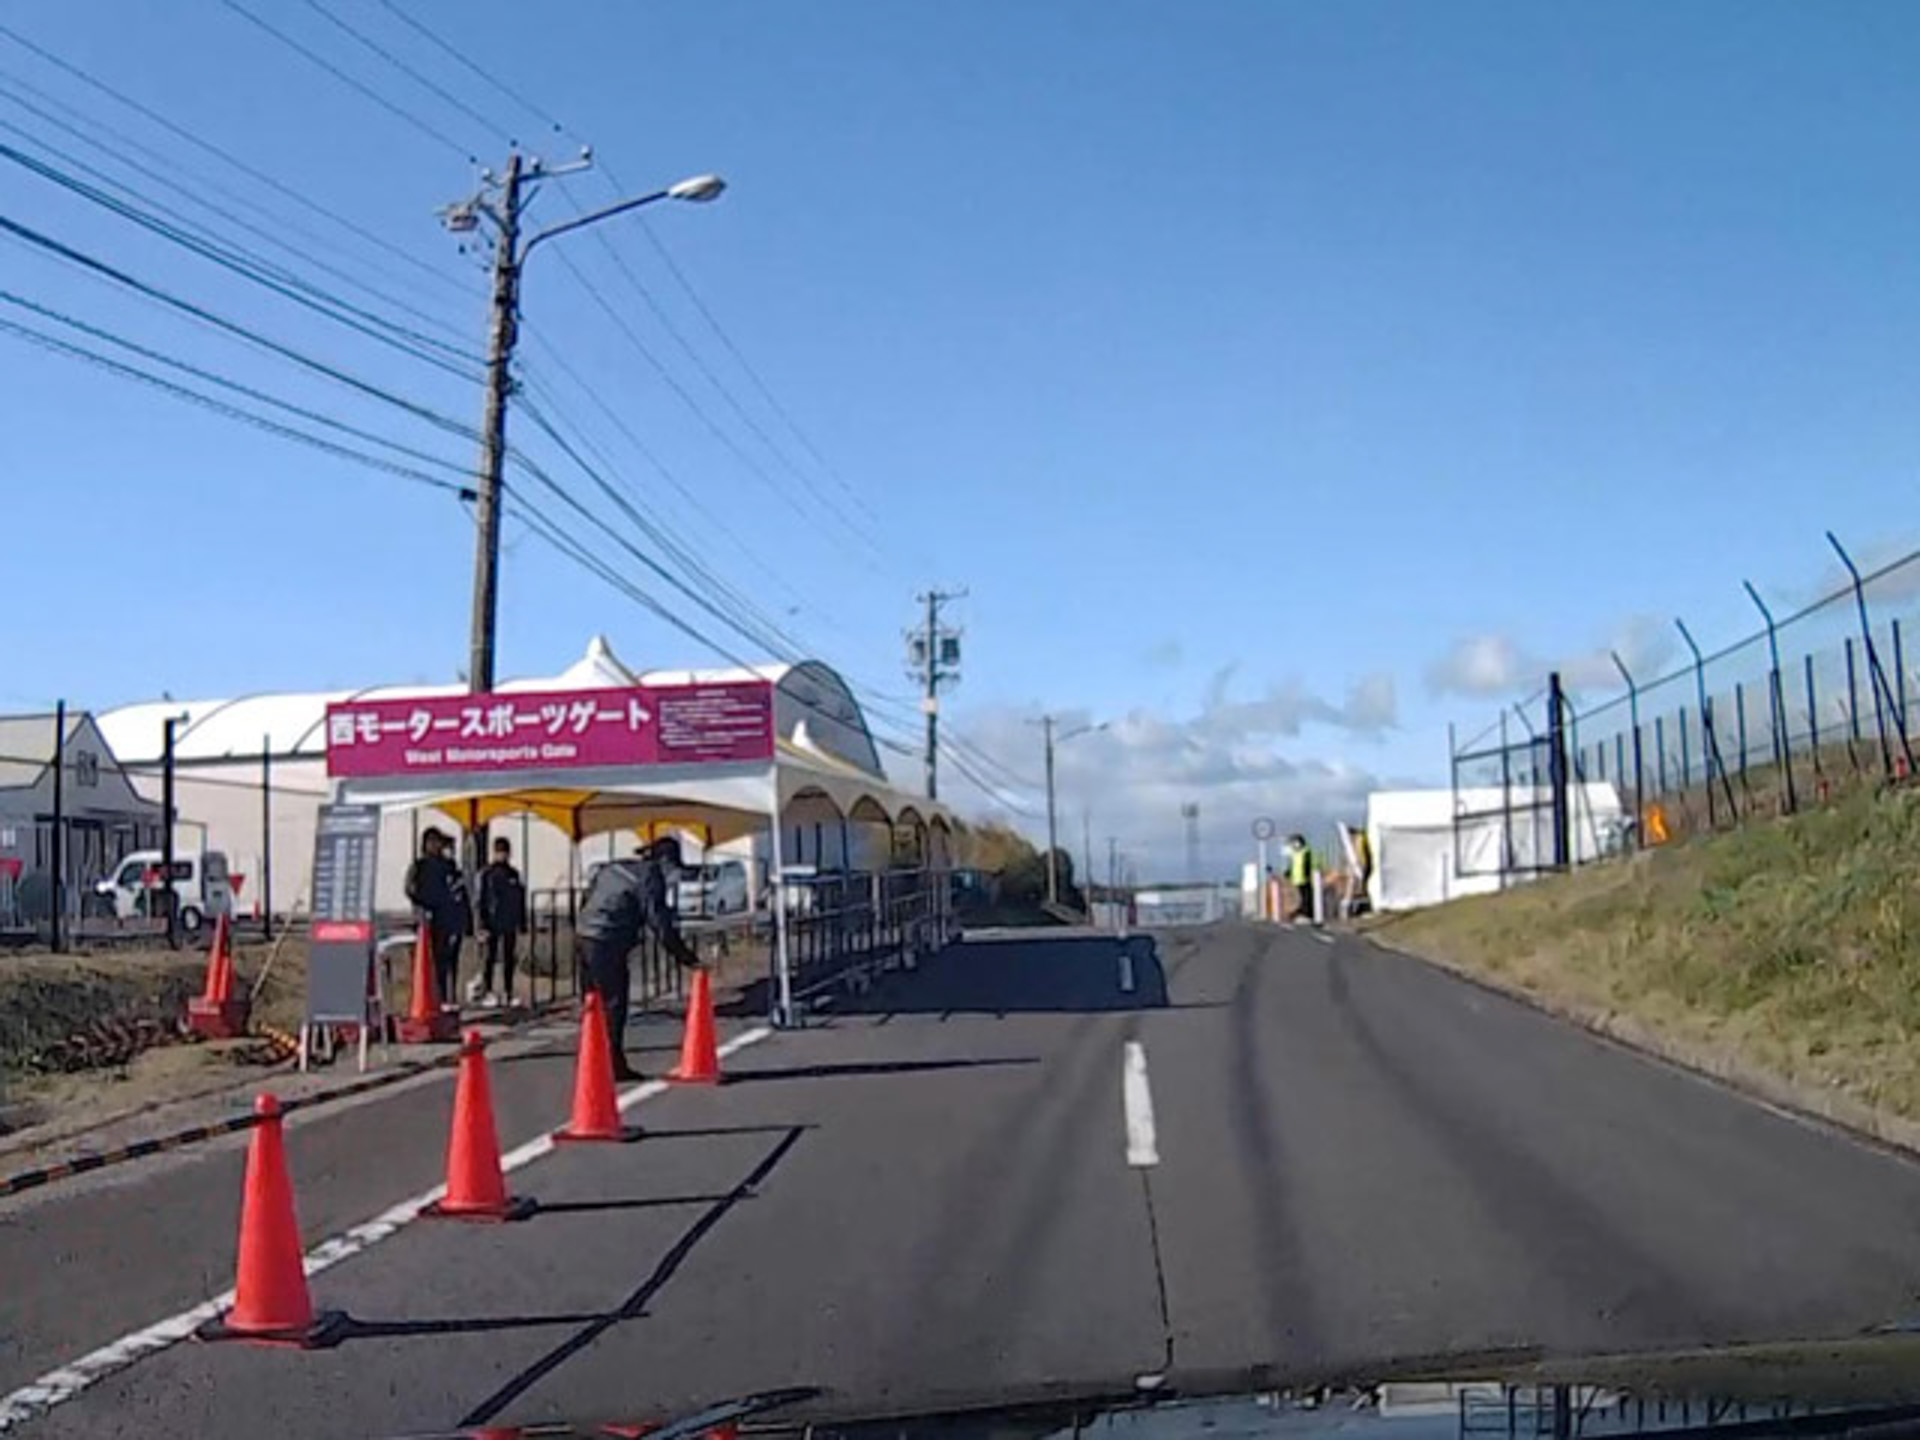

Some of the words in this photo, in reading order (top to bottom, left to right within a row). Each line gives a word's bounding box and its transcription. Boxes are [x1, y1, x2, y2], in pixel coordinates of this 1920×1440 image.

[329, 699, 651, 746] 西モータースポーツゲート
[404, 749, 442, 765] West
[446, 746, 538, 764] Motorsports
[541, 743, 577, 759] Gate
